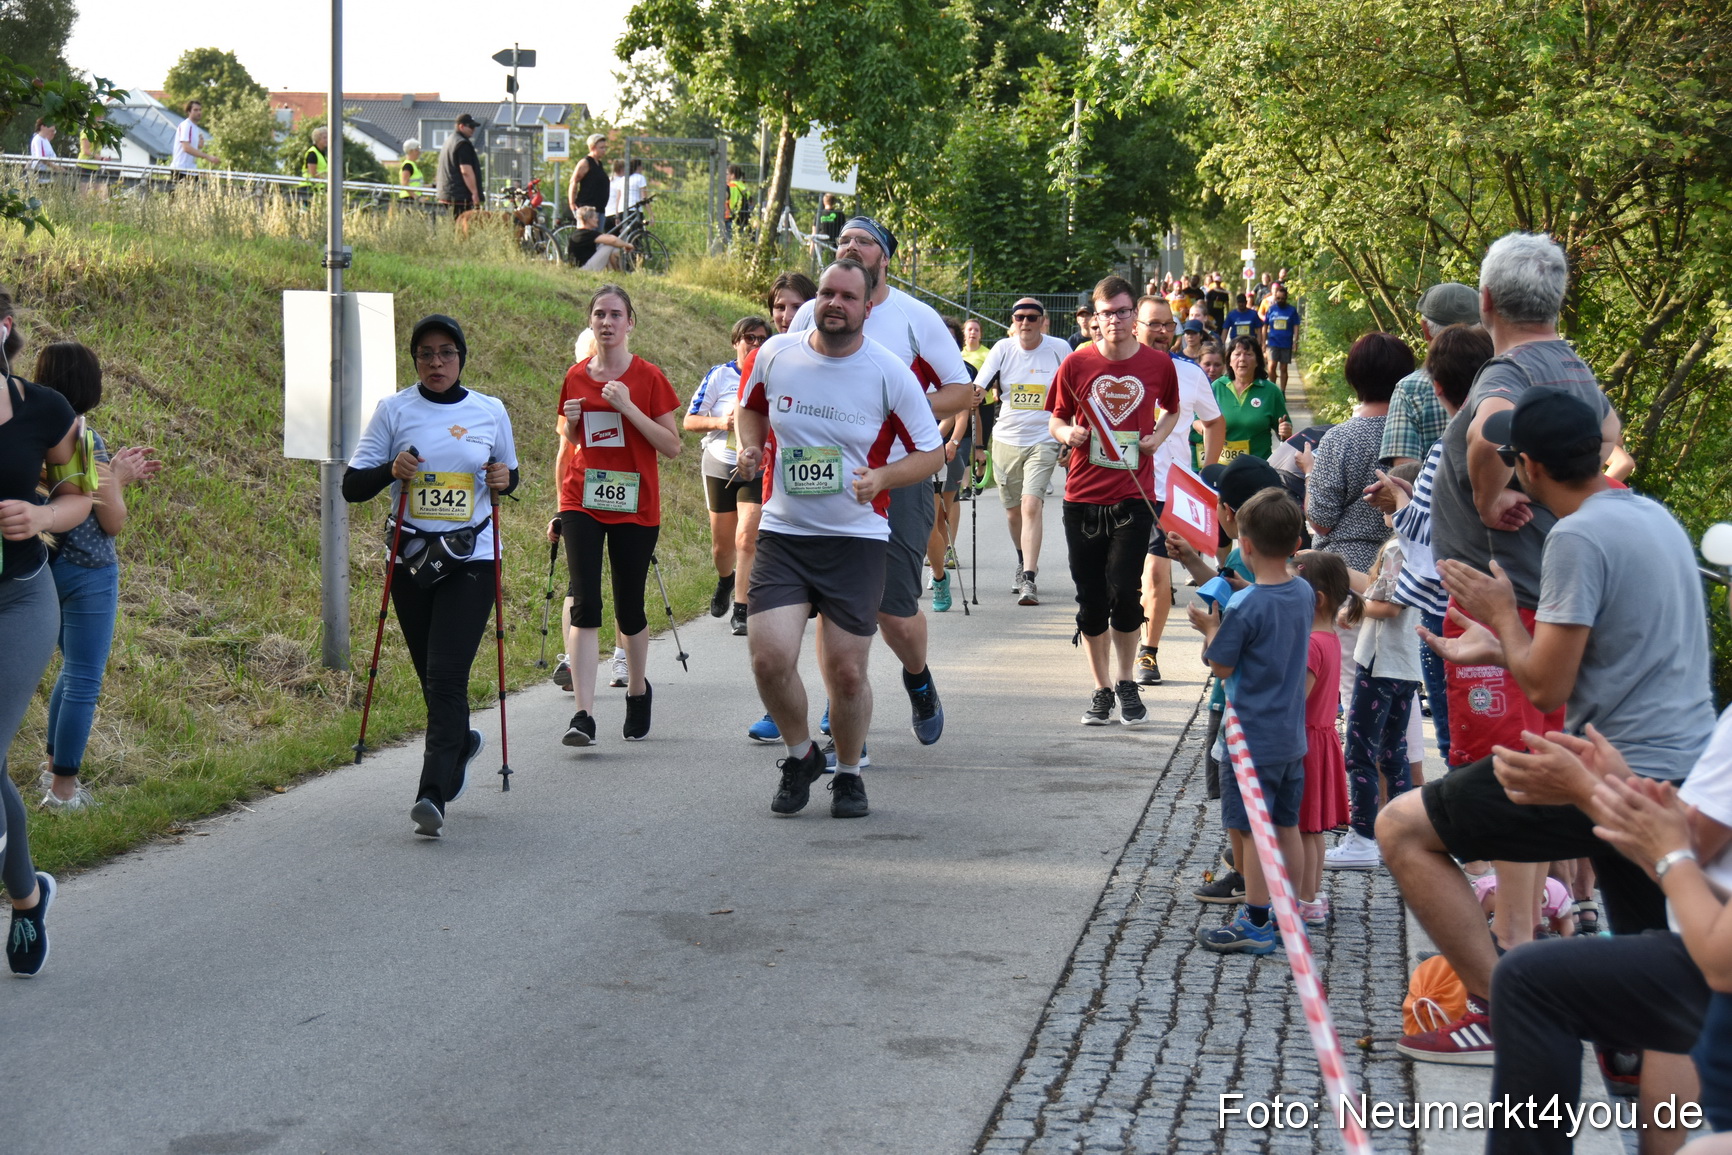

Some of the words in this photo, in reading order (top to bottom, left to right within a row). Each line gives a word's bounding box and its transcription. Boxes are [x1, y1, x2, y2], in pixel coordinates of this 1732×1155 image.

[1014, 393, 1040, 403] 2372
[1105, 391, 1130, 399] Johannes
[795, 401, 866, 426] intellitools
[788, 463, 834, 481] 1094
[418, 489, 467, 507] 1342
[595, 484, 626, 501] 468
